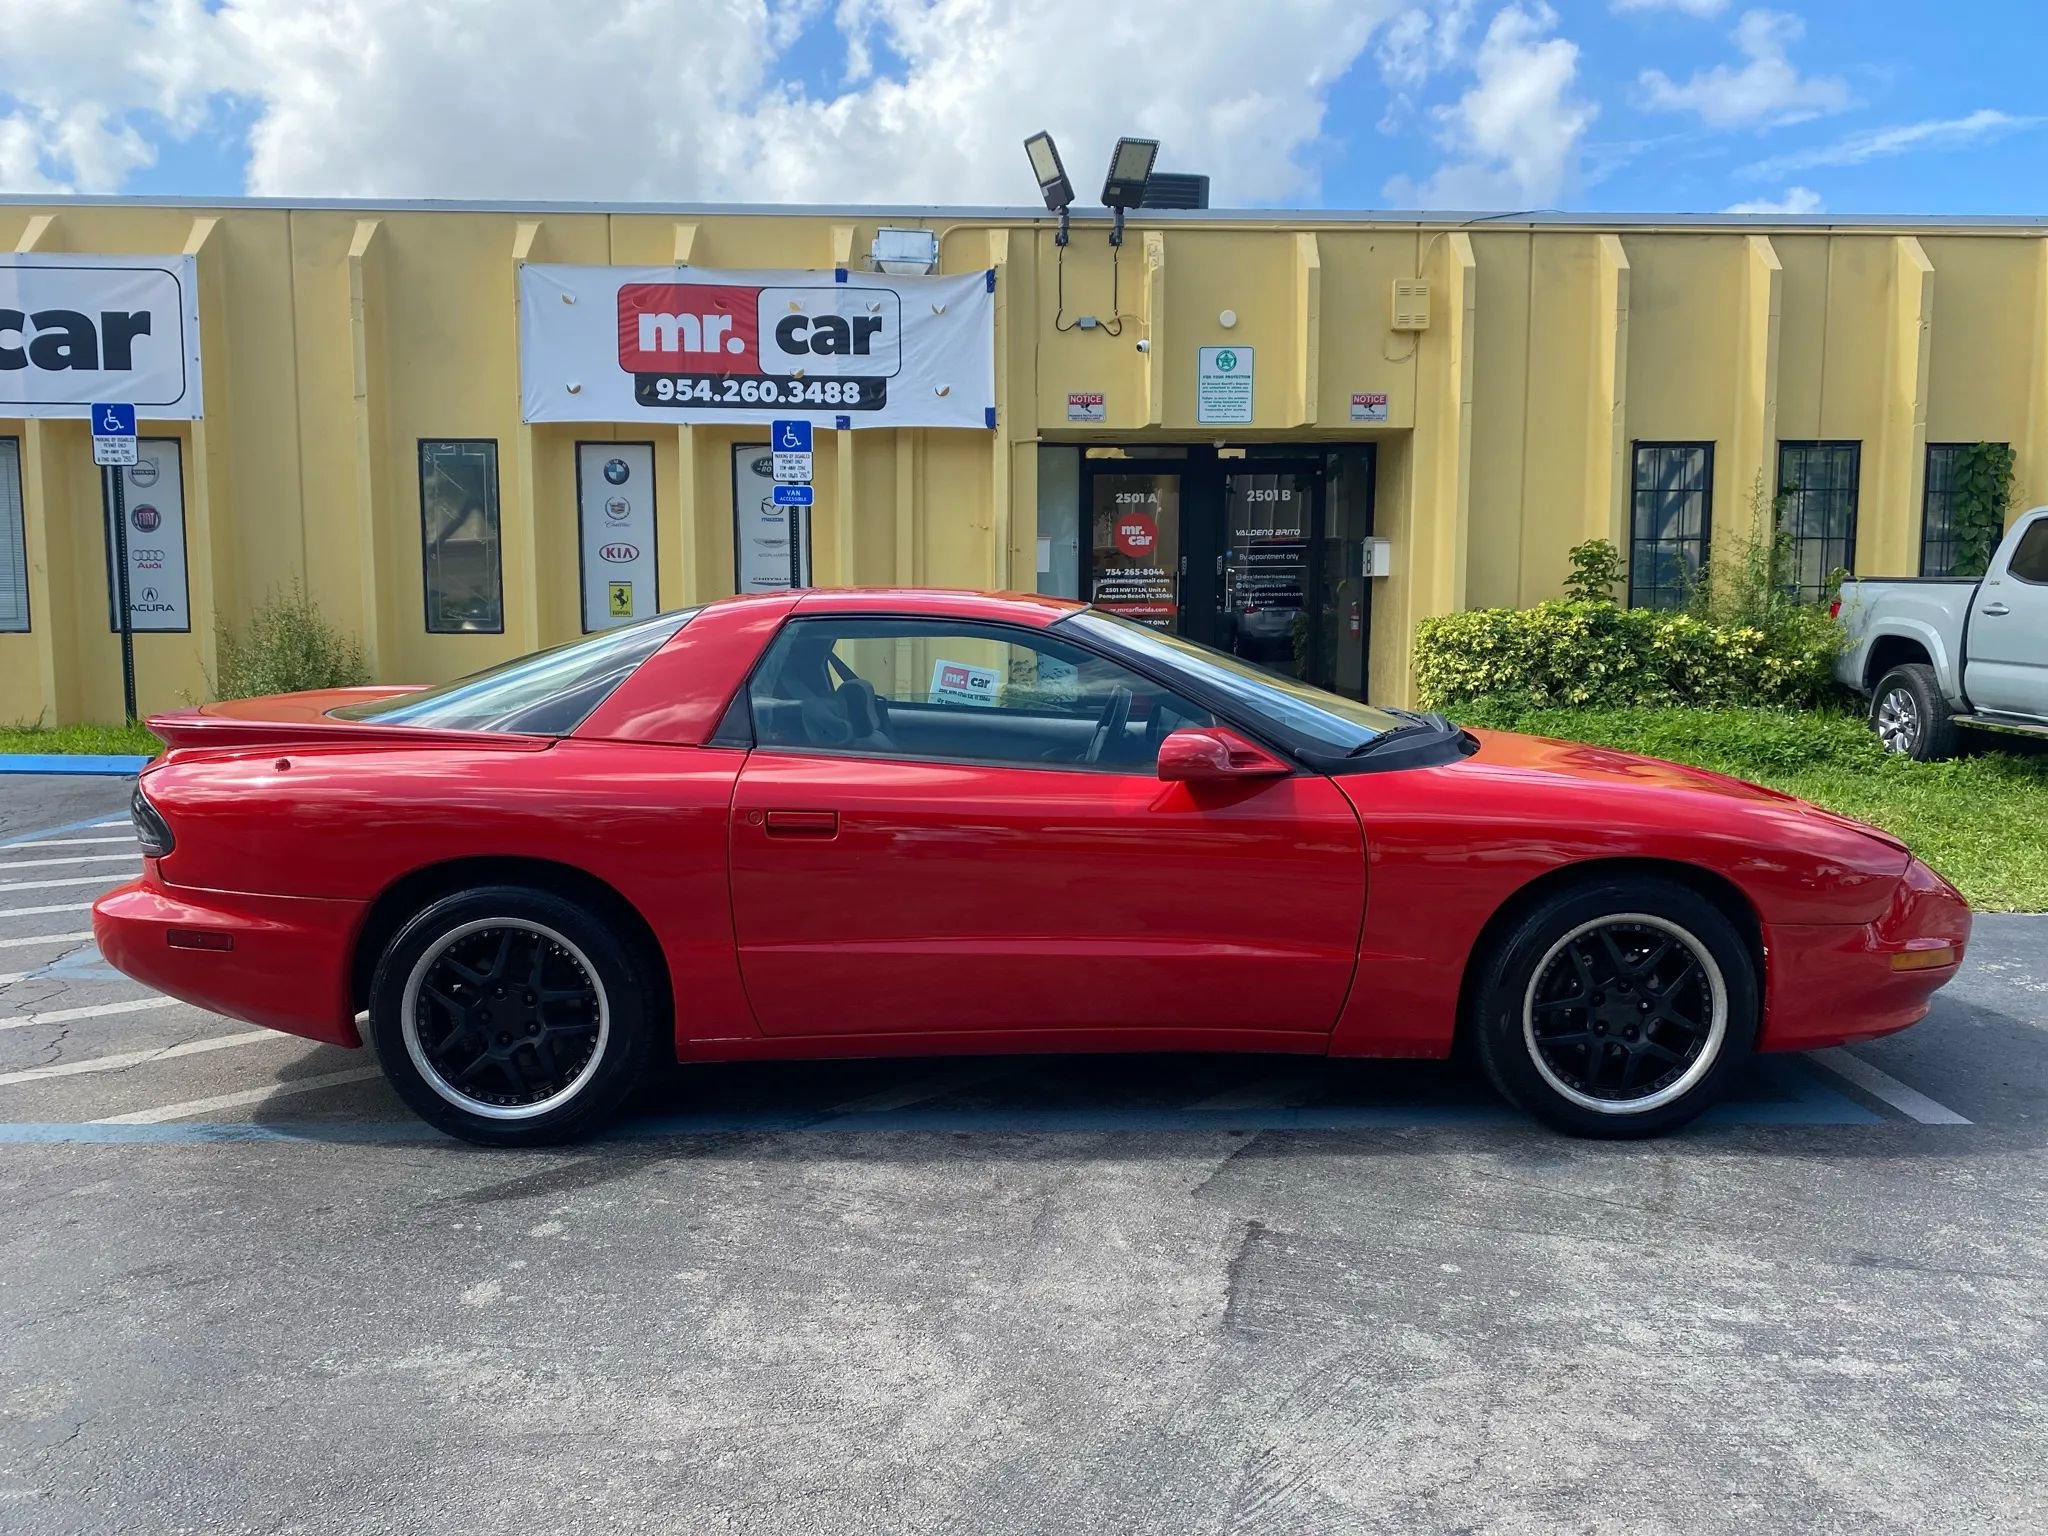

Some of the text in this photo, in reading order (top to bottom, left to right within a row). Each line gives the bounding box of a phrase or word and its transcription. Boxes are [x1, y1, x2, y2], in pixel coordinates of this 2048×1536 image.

[638, 312, 882, 355] mr. car
[655, 378, 861, 404] 954.260.3488
[1070, 395, 1102, 403] NOTICE
[1353, 395, 1385, 403] NOTICE
[1115, 493, 1158, 503] 2501 A
[1246, 489, 1291, 501] 2501 B
[138, 512, 155, 526] FIAT
[1121, 525, 1145, 535] mr.
[1128, 535, 1153, 546] car
[606, 547, 633, 558] KIA
[1239, 553, 1300, 562] By appointment only
[137, 561, 162, 569] Audi
[1105, 568, 1165, 576] 754-265-8044
[130, 604, 175, 612] ACURA
[944, 673, 990, 688] mr. car
